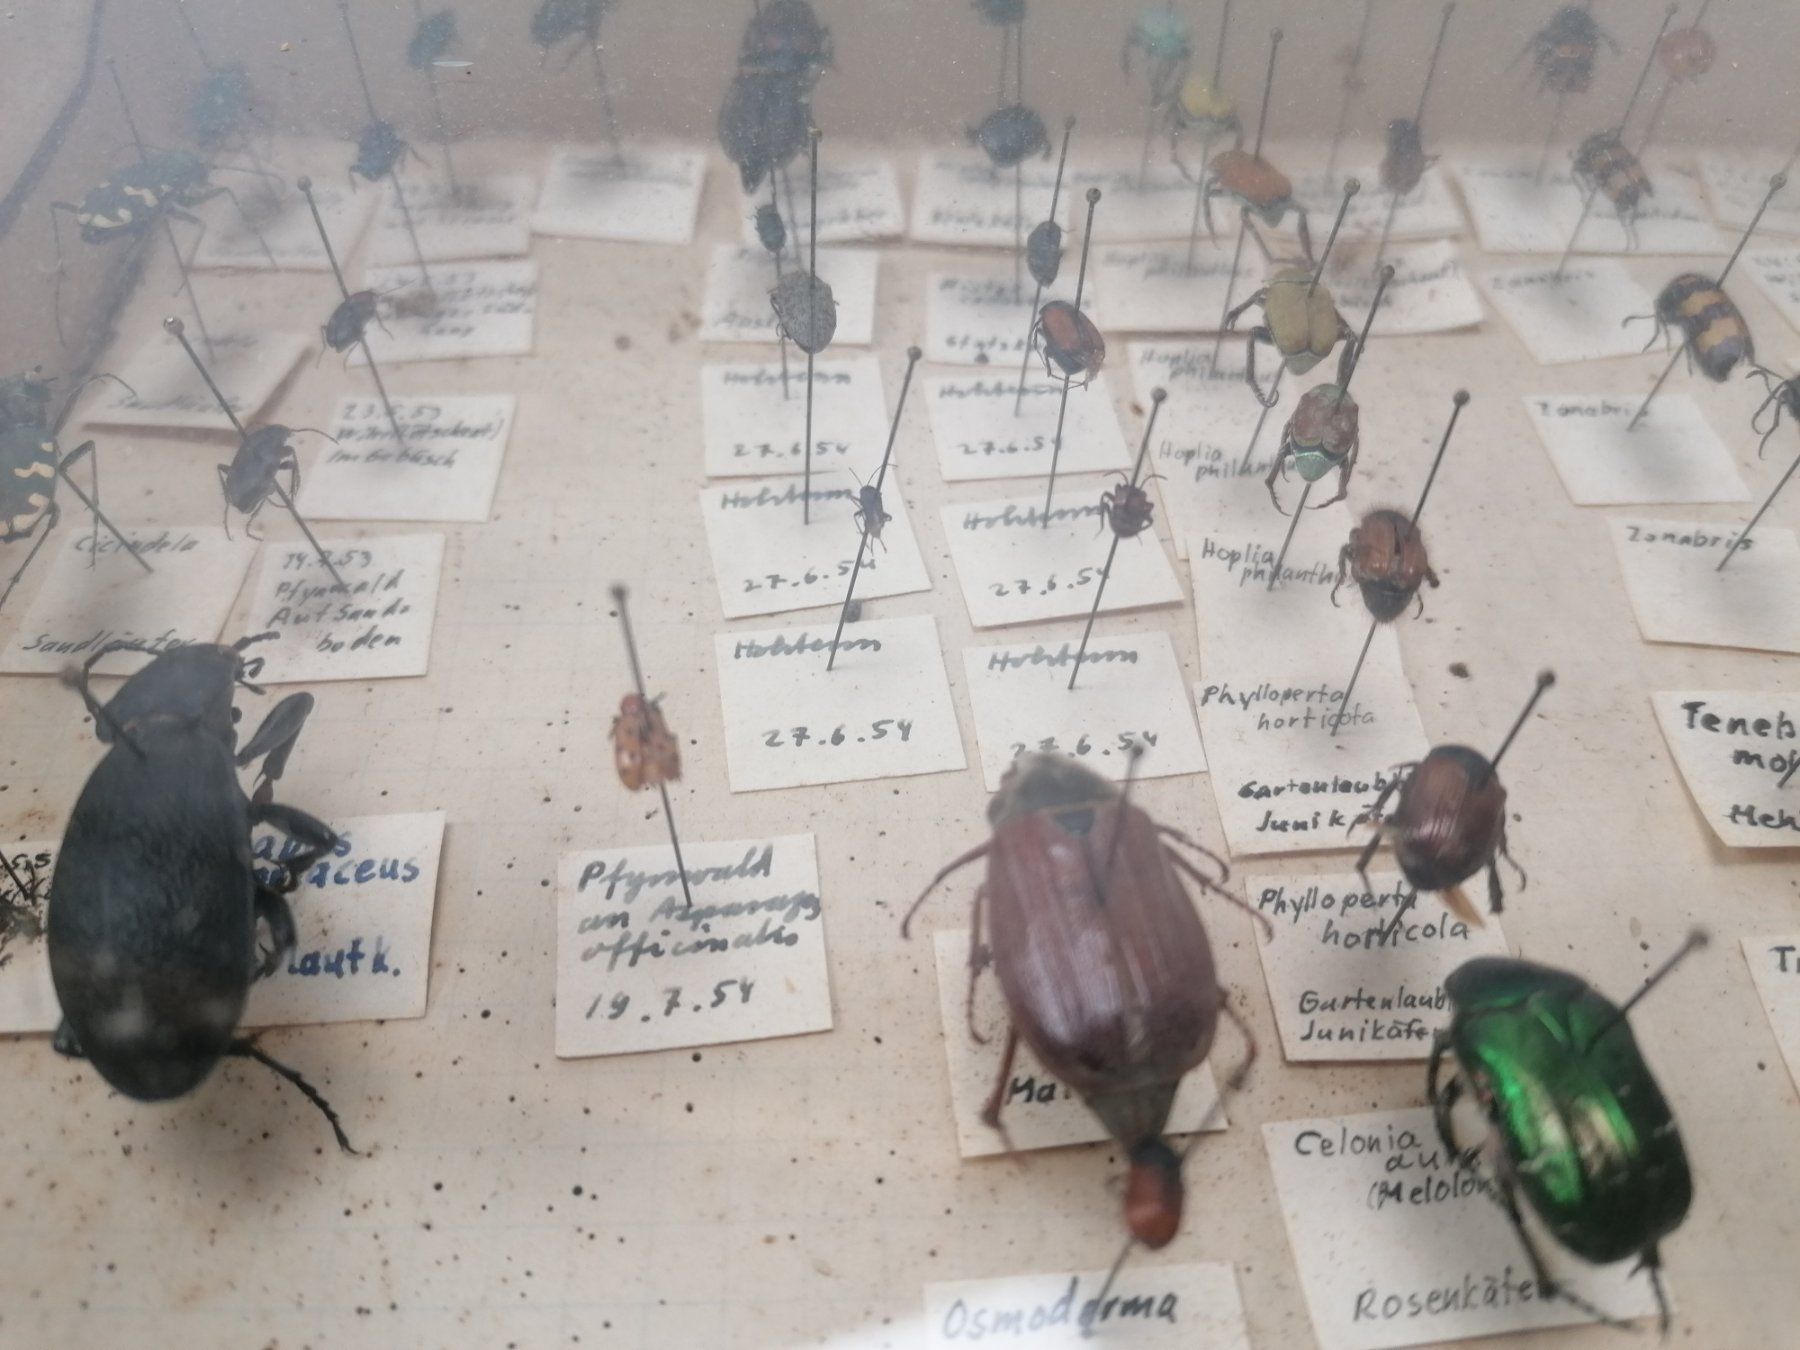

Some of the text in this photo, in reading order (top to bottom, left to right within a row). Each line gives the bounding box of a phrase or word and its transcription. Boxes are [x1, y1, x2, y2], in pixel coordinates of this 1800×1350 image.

[1159, 440, 1223, 466] Hoplia
[1200, 537, 1277, 571] Hoplia
[1201, 682, 1348, 711] Phylloperta
[762, 718, 914, 749] 27.6.54
[1321, 911, 1470, 951] horticola
[584, 974, 756, 1021] 19.7.54
[1298, 985, 1450, 1015] Gartenlaub
